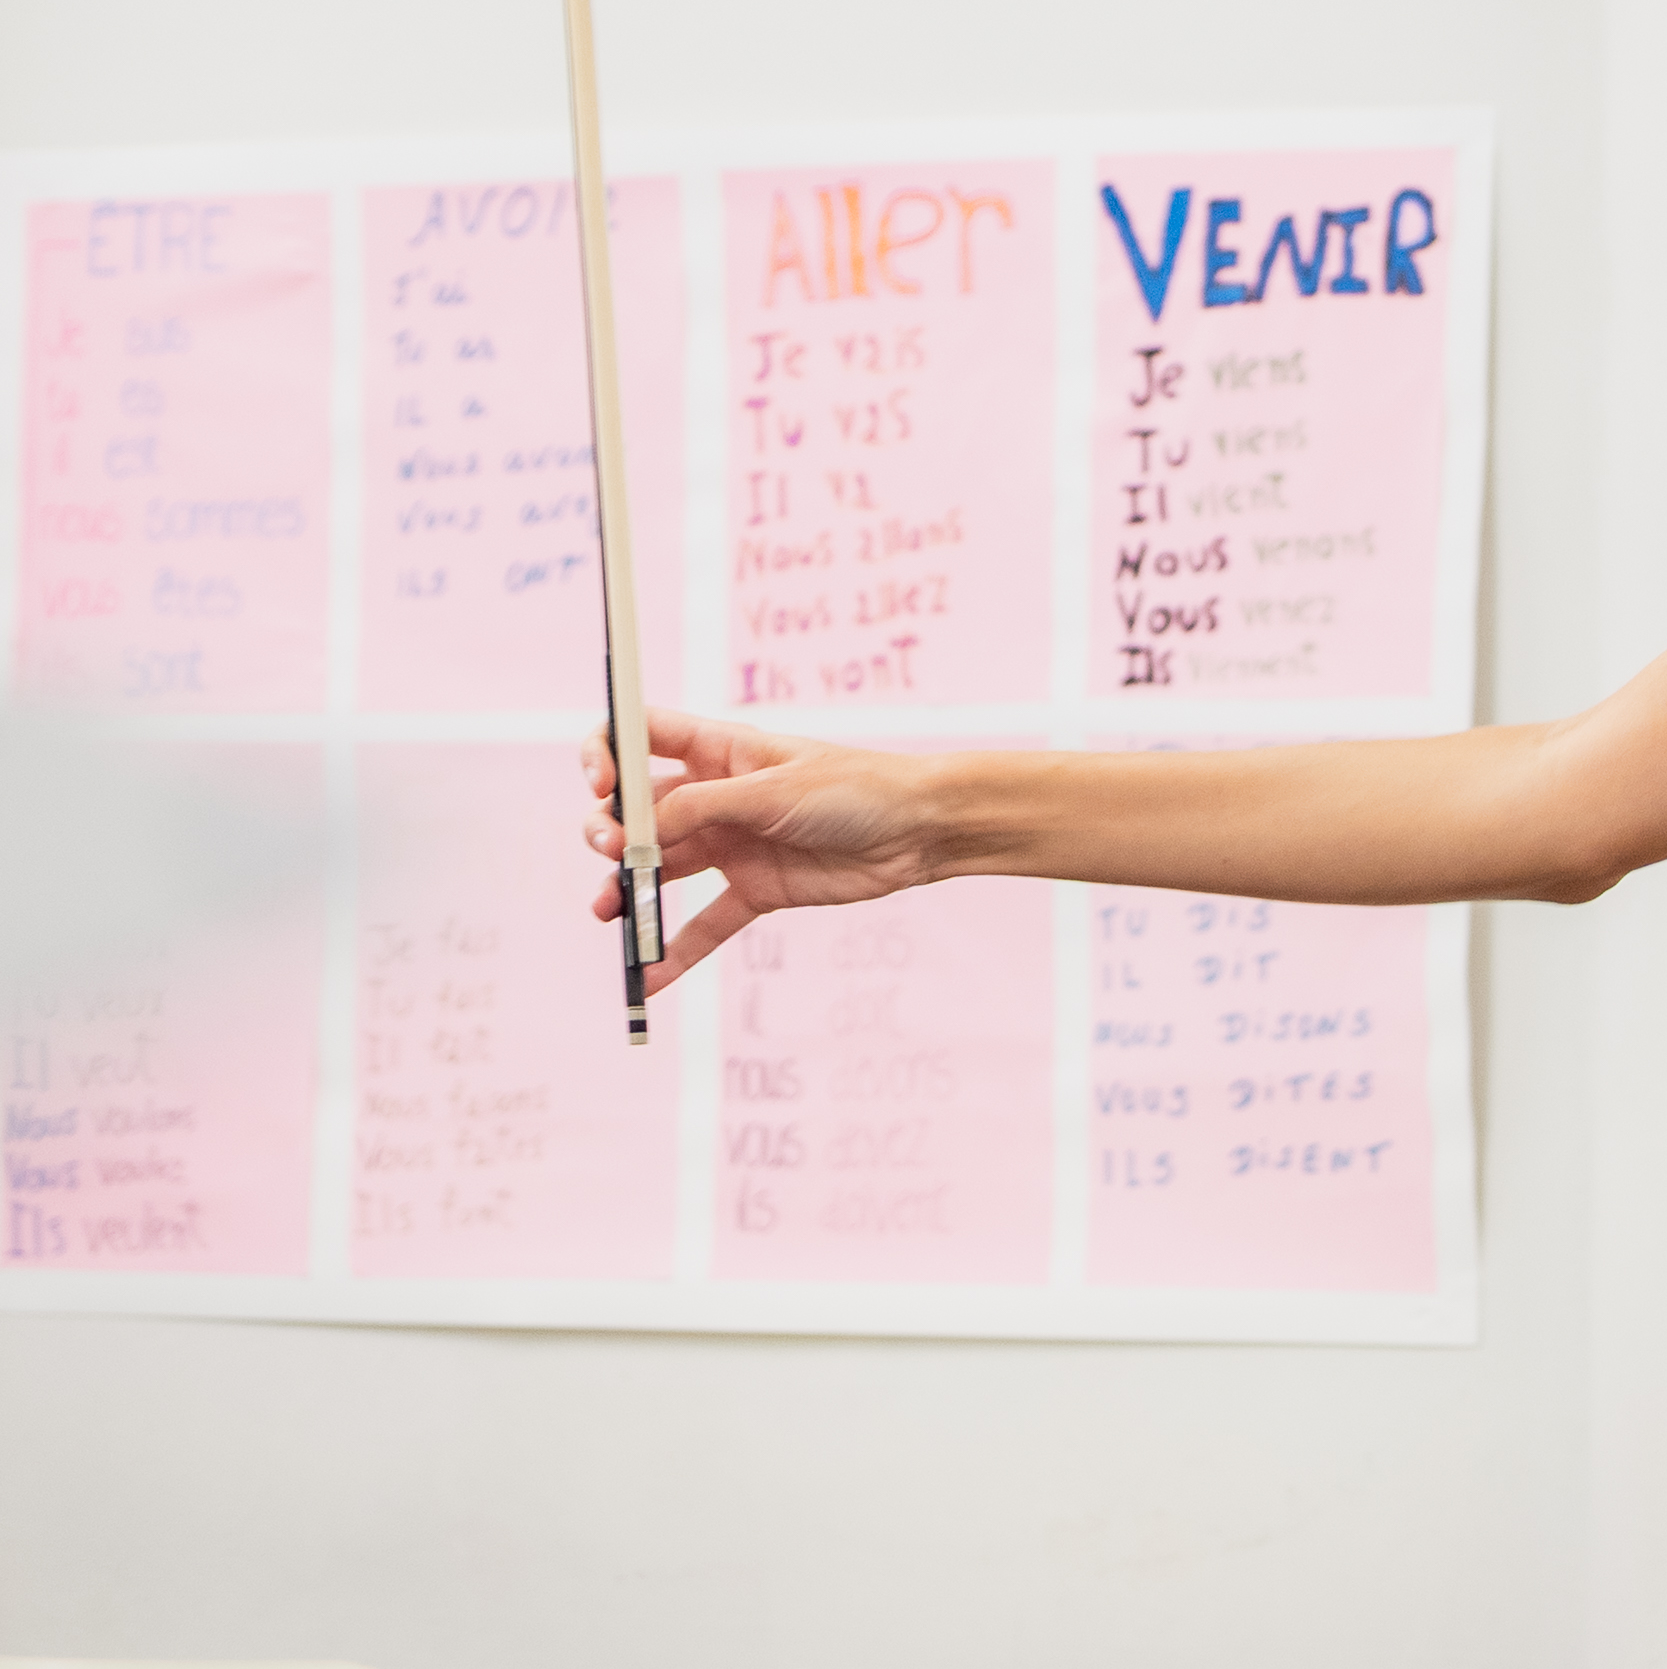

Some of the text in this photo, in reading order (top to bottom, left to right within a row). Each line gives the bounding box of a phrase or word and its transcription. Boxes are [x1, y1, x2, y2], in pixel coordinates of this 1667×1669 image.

[409, 185, 619, 249] AVOI
[762, 183, 1014, 309] Aller
[1098, 182, 1439, 324] VENIR
[748, 331, 806, 381] Je
[1129, 346, 1186, 409] Je
[743, 395, 802, 454] Tu
[1121, 484, 1169, 526] Il
[1114, 535, 1231, 581] Nous
[1114, 589, 1220, 635] Vous
